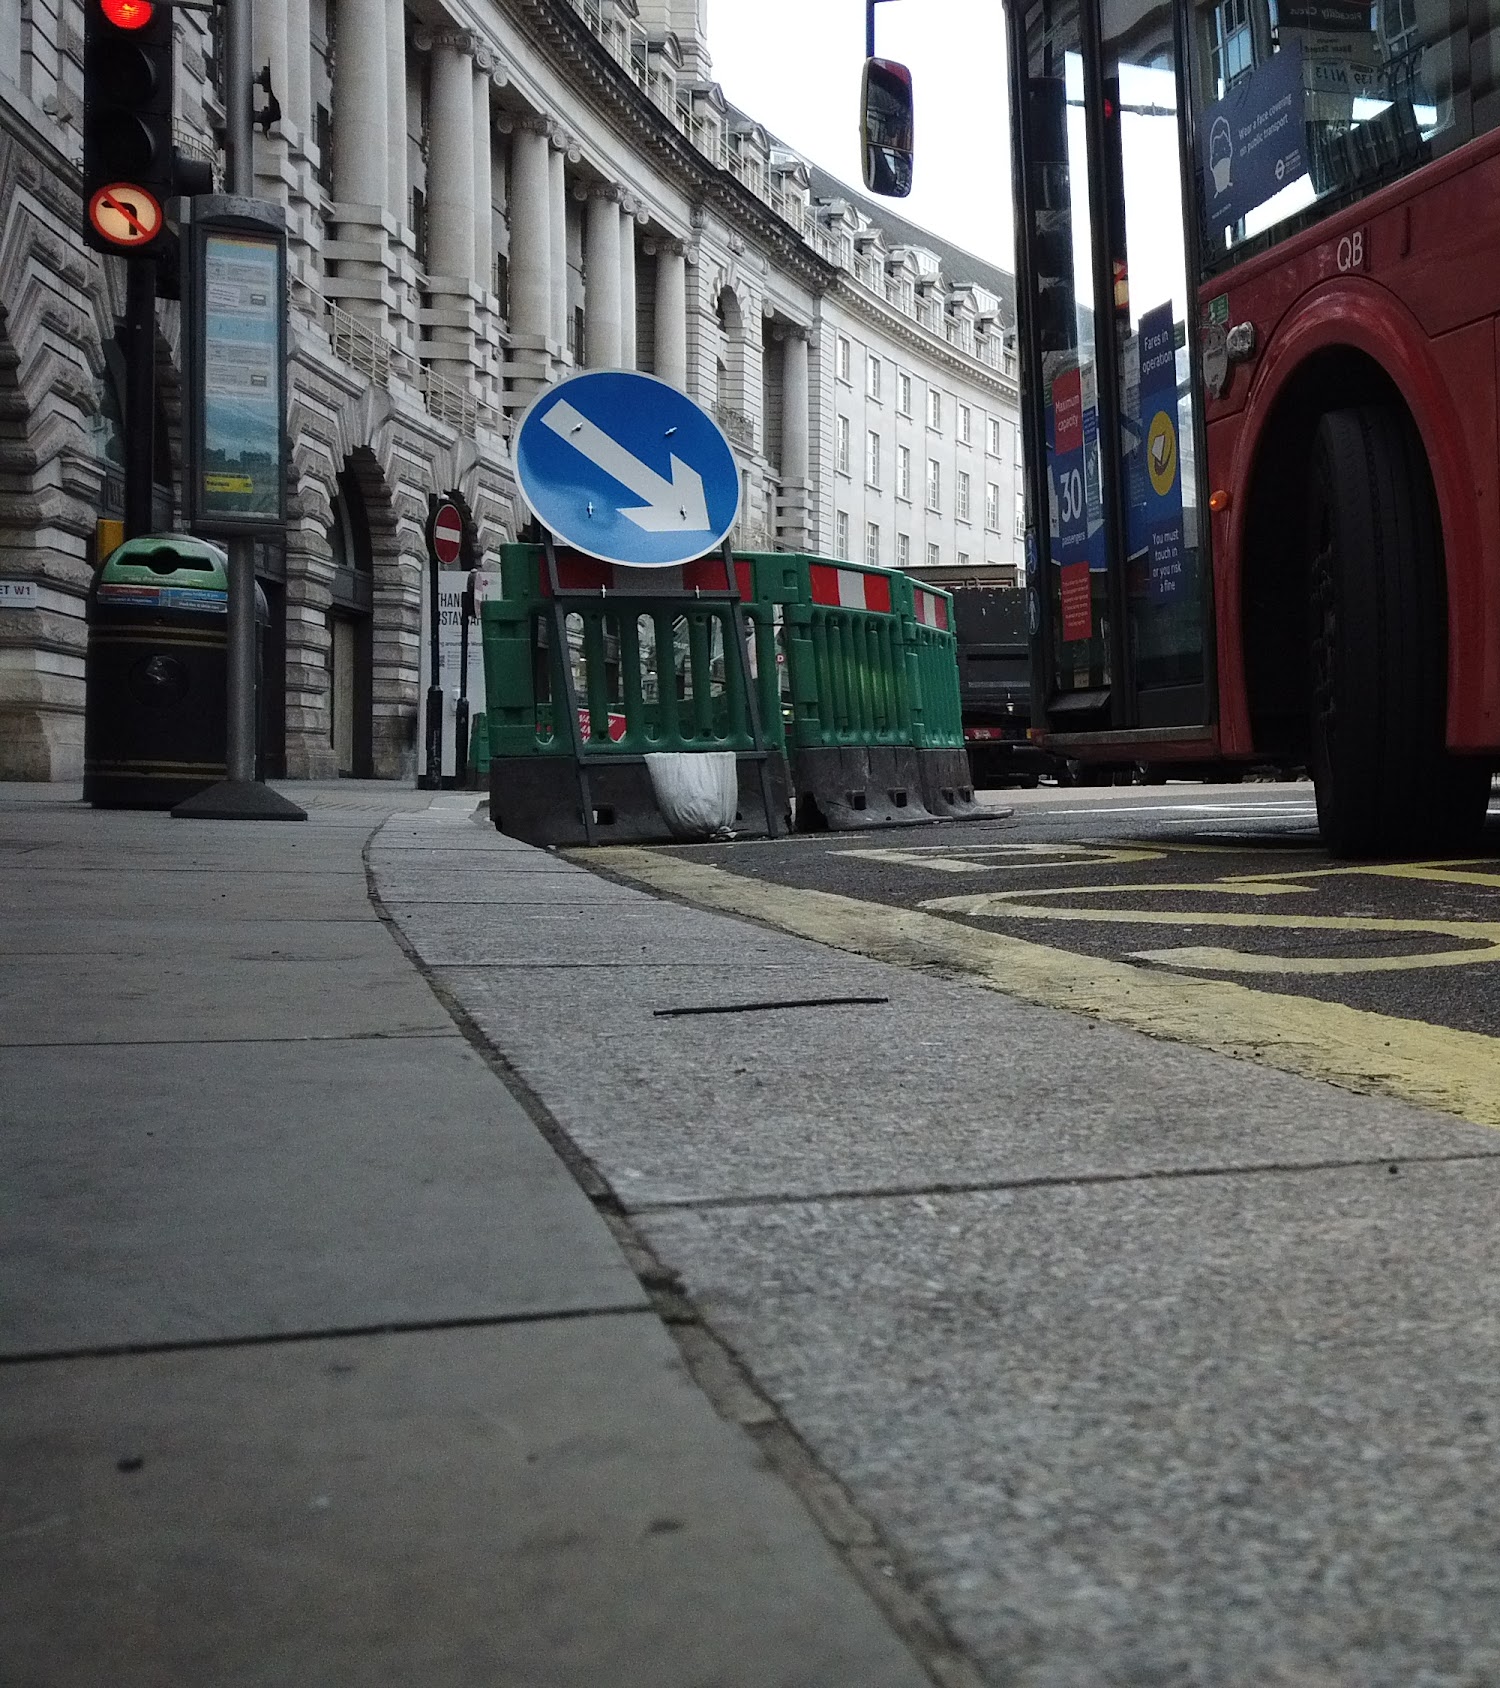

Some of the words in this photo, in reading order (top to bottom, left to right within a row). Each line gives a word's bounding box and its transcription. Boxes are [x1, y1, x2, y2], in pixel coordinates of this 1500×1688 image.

[1238, 127, 1252, 140] Wear
[1256, 111, 1268, 127] face
[1268, 94, 1292, 117] covering
[1247, 133, 1264, 153] public
[1264, 114, 1289, 139] transport
[1336, 230, 1364, 272] QB
[1144, 334, 1161, 352] Fares
[1162, 328, 1169, 344] in
[1142, 350, 1173, 375] operation
[1055, 394, 1080, 414] Maximum
[1057, 413, 1079, 434] capacity
[1060, 467, 1082, 523] 30
[1061, 530, 1086, 549] passengers
[1152, 532, 1164, 545] You
[1164, 528, 1179, 542] must
[1154, 546, 1171, 562] touch
[1172, 546, 1178, 558] in
[1152, 568, 1159, 578] or
[1159, 566, 1170, 580] you
[1171, 561, 1182, 575] risk
[14, 586, 30, 596] W1
[1164, 579, 1176, 592] fine
